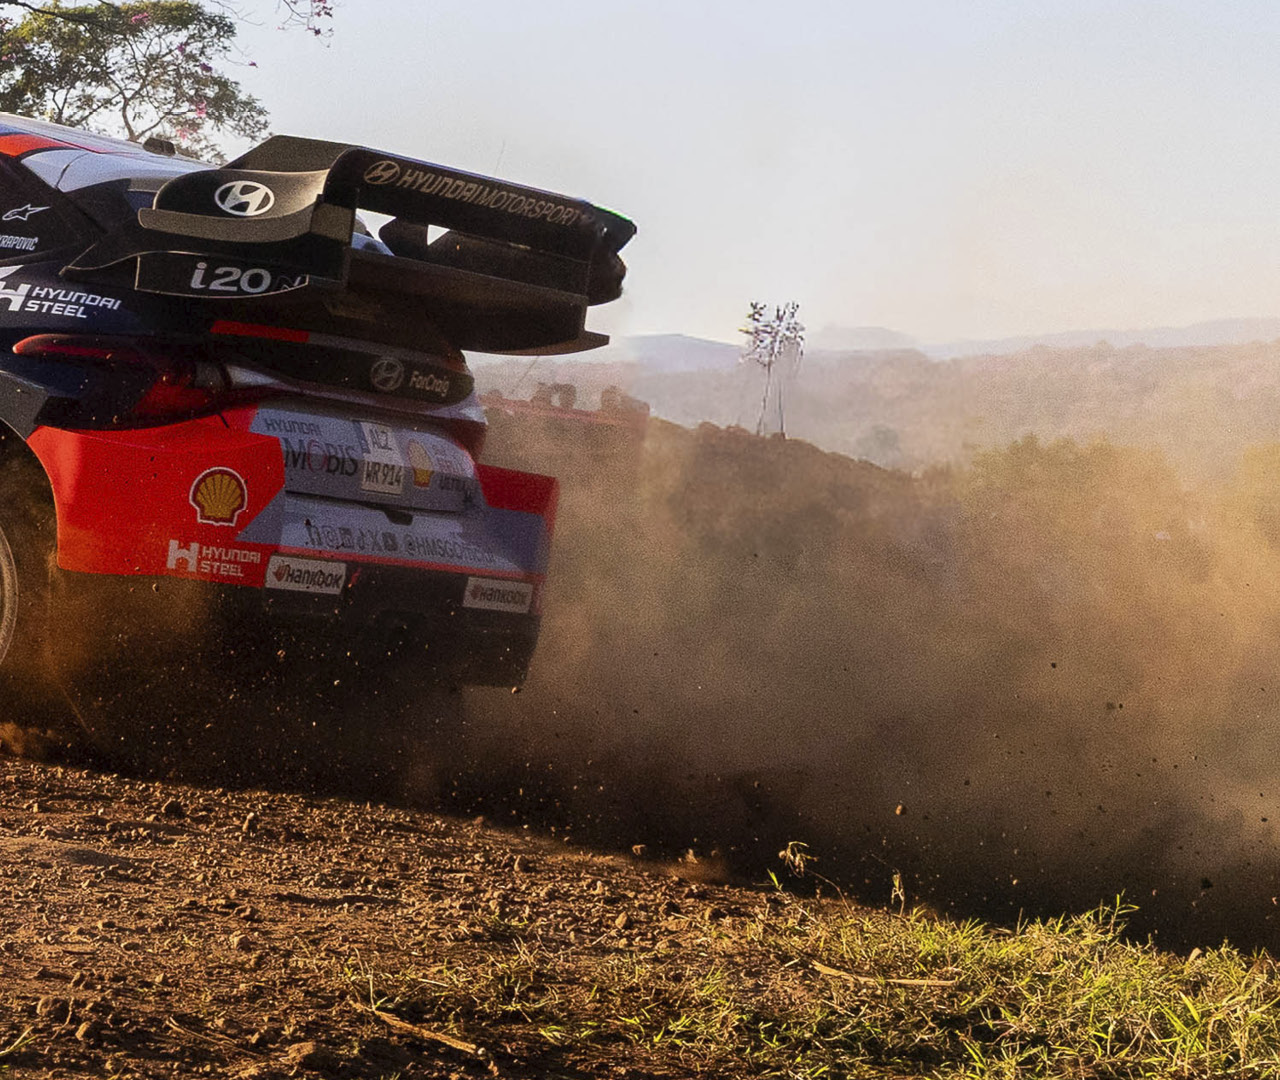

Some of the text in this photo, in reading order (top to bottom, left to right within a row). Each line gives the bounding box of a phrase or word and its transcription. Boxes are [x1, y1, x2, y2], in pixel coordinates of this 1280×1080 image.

[190, 262, 271, 293] i20
[32, 286, 121, 310] HYUNDAI
[25, 300, 88, 319] STEEL
[266, 418, 322, 436] HYUNDAI
[283, 437, 358, 477] MOBIS
[201, 545, 261, 564] HYUNDAI
[200, 562, 244, 577] STEEL
